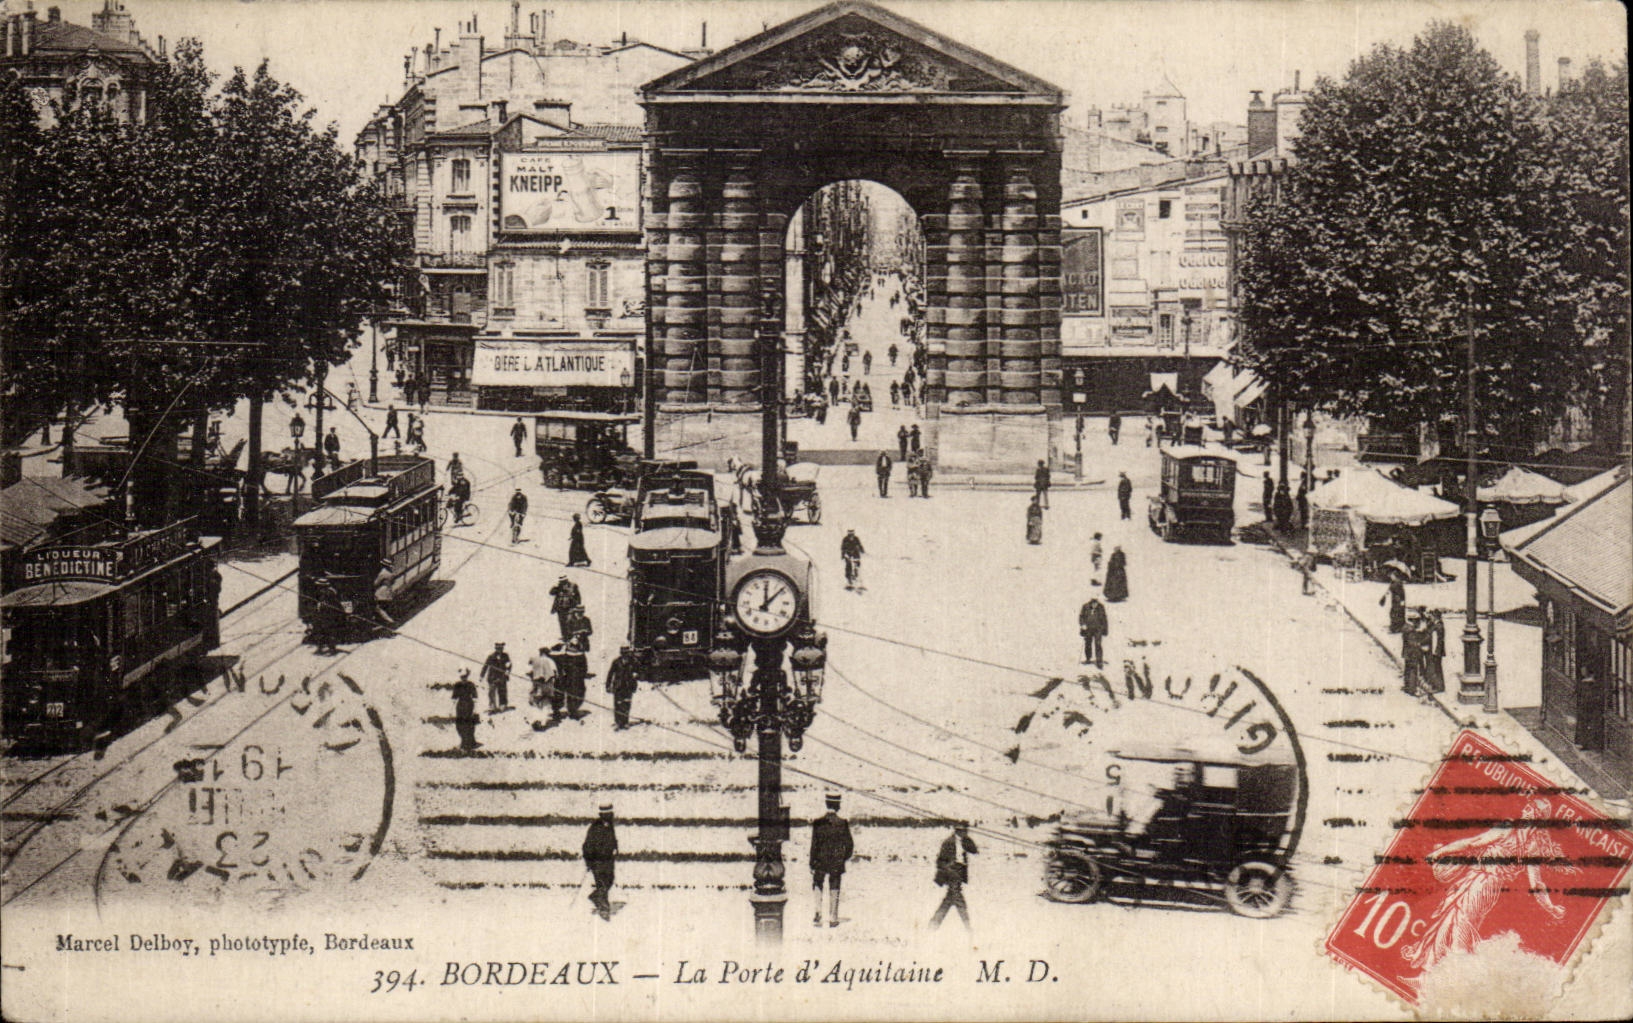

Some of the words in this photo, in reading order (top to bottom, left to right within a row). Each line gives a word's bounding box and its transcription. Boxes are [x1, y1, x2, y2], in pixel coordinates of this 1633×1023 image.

[510, 175, 563, 193] KNEIPP
[604, 206, 620, 221] 1
[37, 550, 100, 561] LIQUEUR
